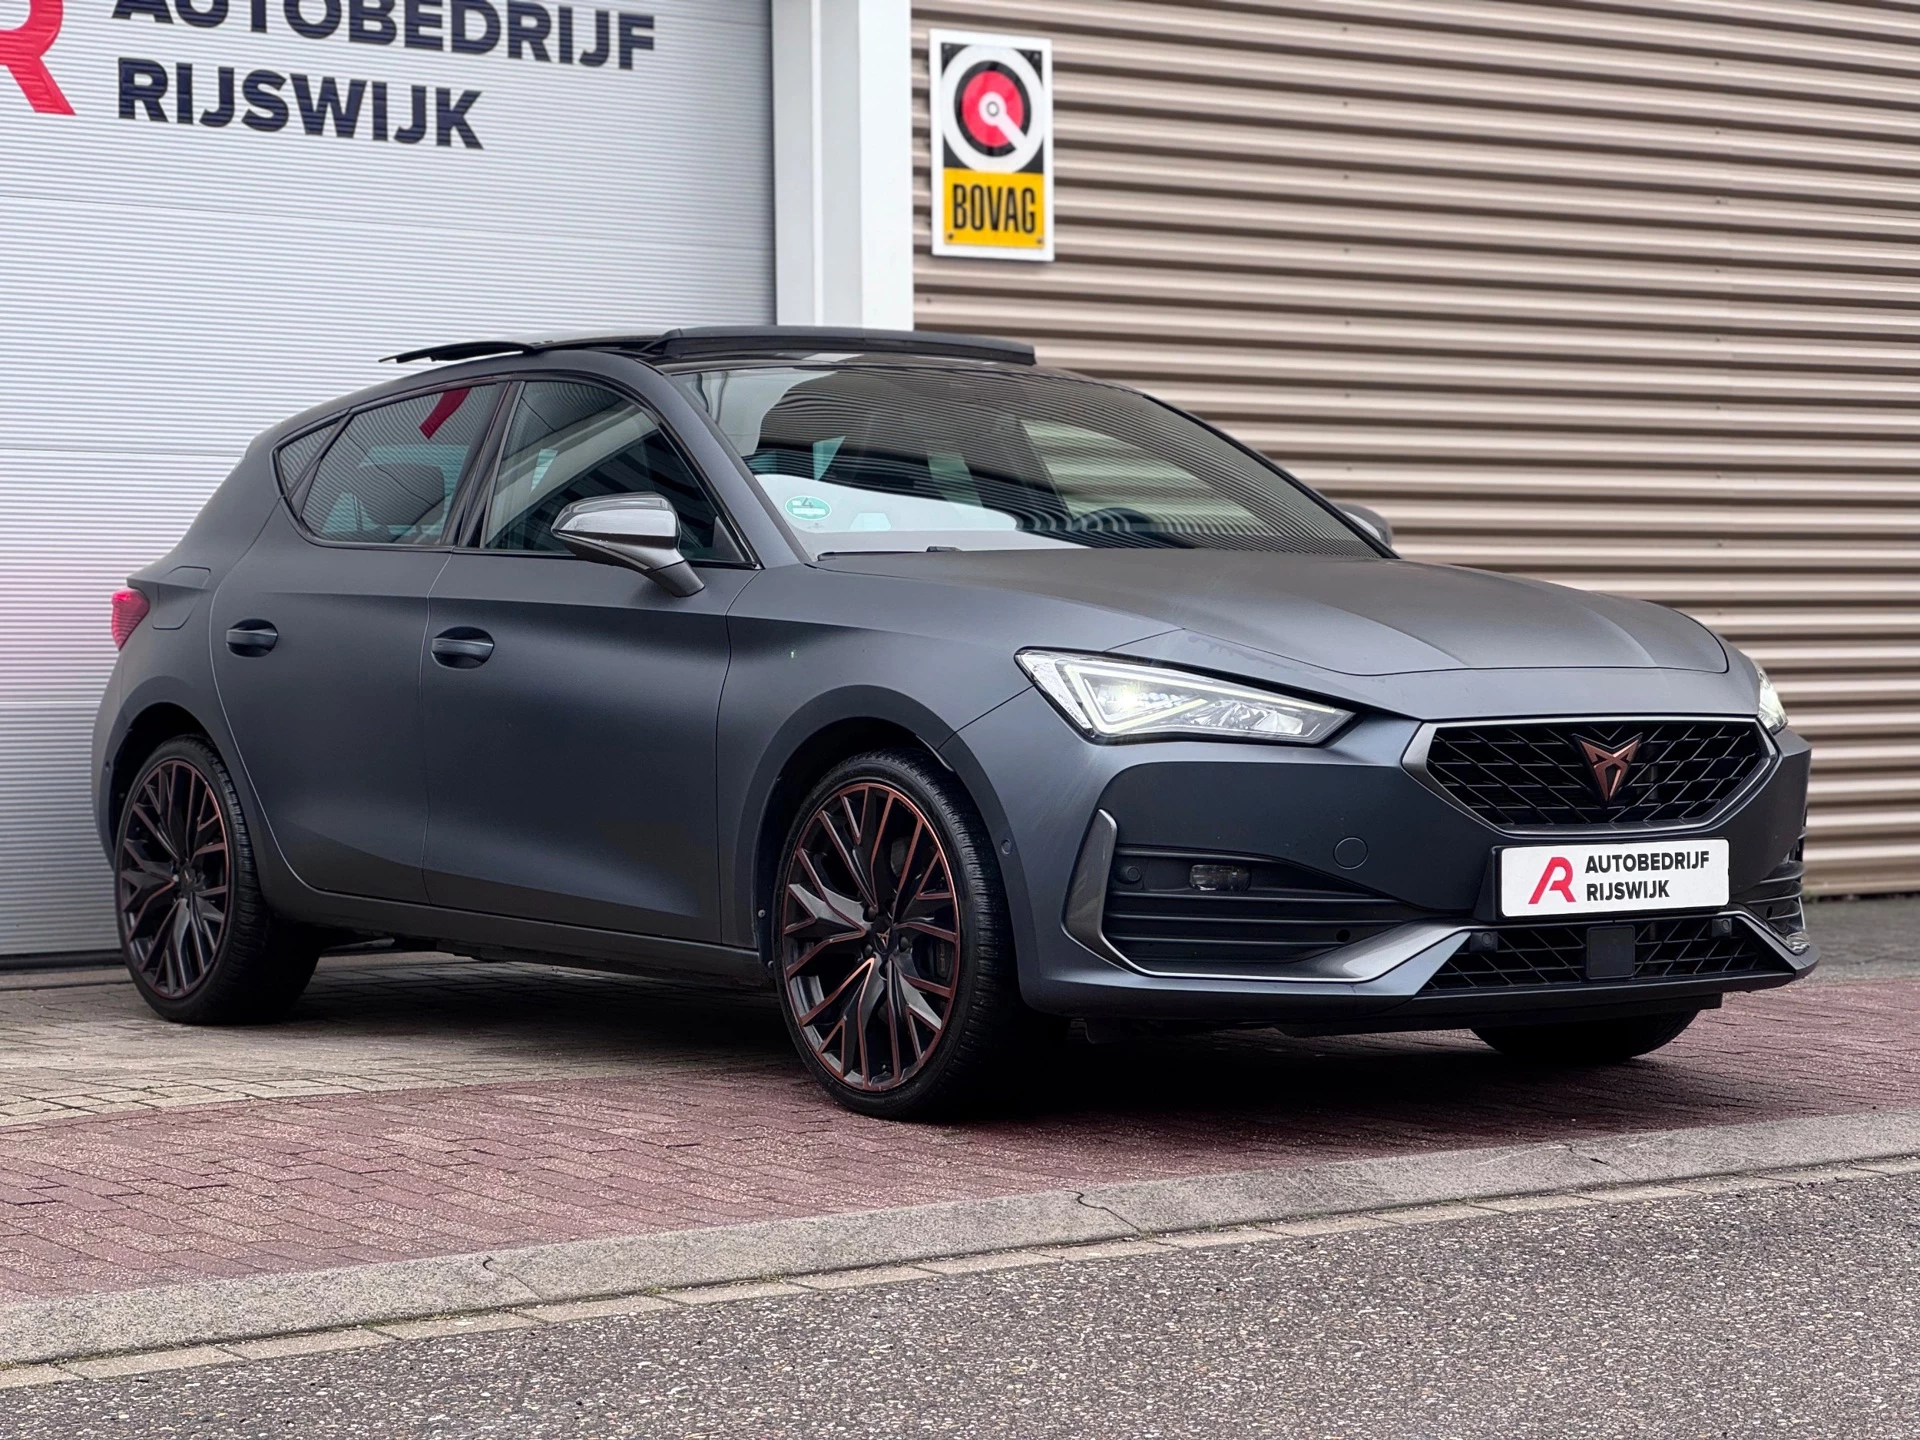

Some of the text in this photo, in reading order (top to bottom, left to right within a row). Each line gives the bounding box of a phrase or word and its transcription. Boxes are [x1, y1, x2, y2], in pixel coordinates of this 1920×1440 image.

[118, 57, 484, 150] RIJSWIJK
[952, 184, 1035, 234] BOVAG
[1584, 850, 1710, 874] AUTOBEDRIJF
[1586, 879, 1670, 902] RIJSWIJK
